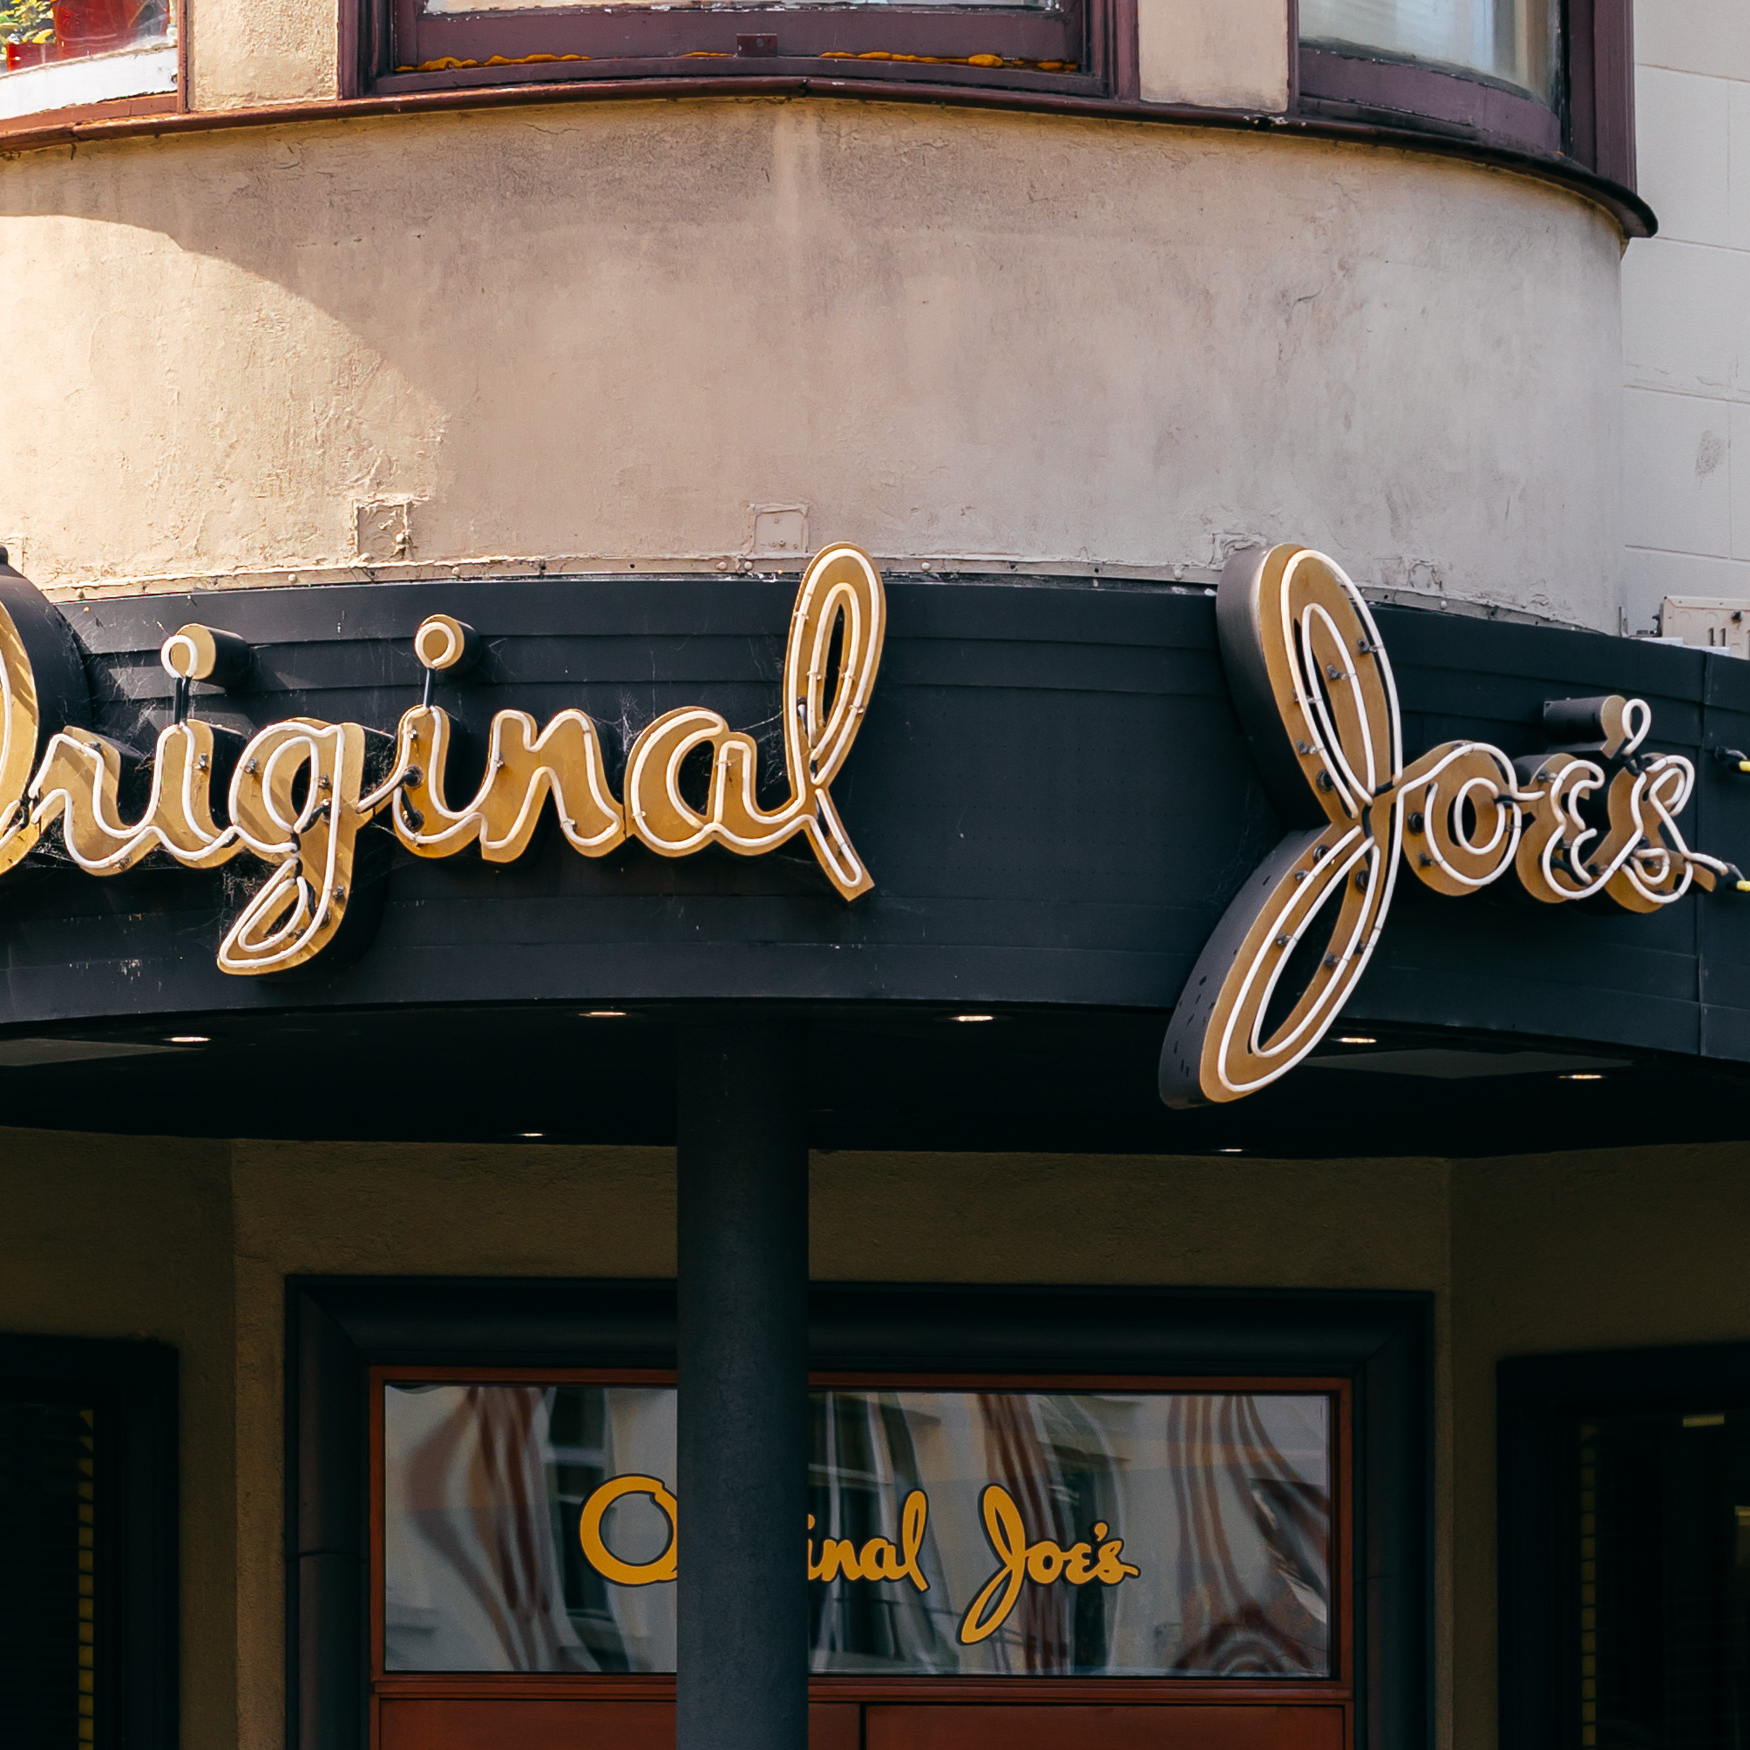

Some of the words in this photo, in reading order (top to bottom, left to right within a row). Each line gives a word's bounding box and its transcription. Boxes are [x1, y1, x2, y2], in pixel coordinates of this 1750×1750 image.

[1198, 542, 1736, 1106] Joe's
[577, 1473, 932, 1594] Oinal
[957, 1483, 1141, 1646] Joe's
